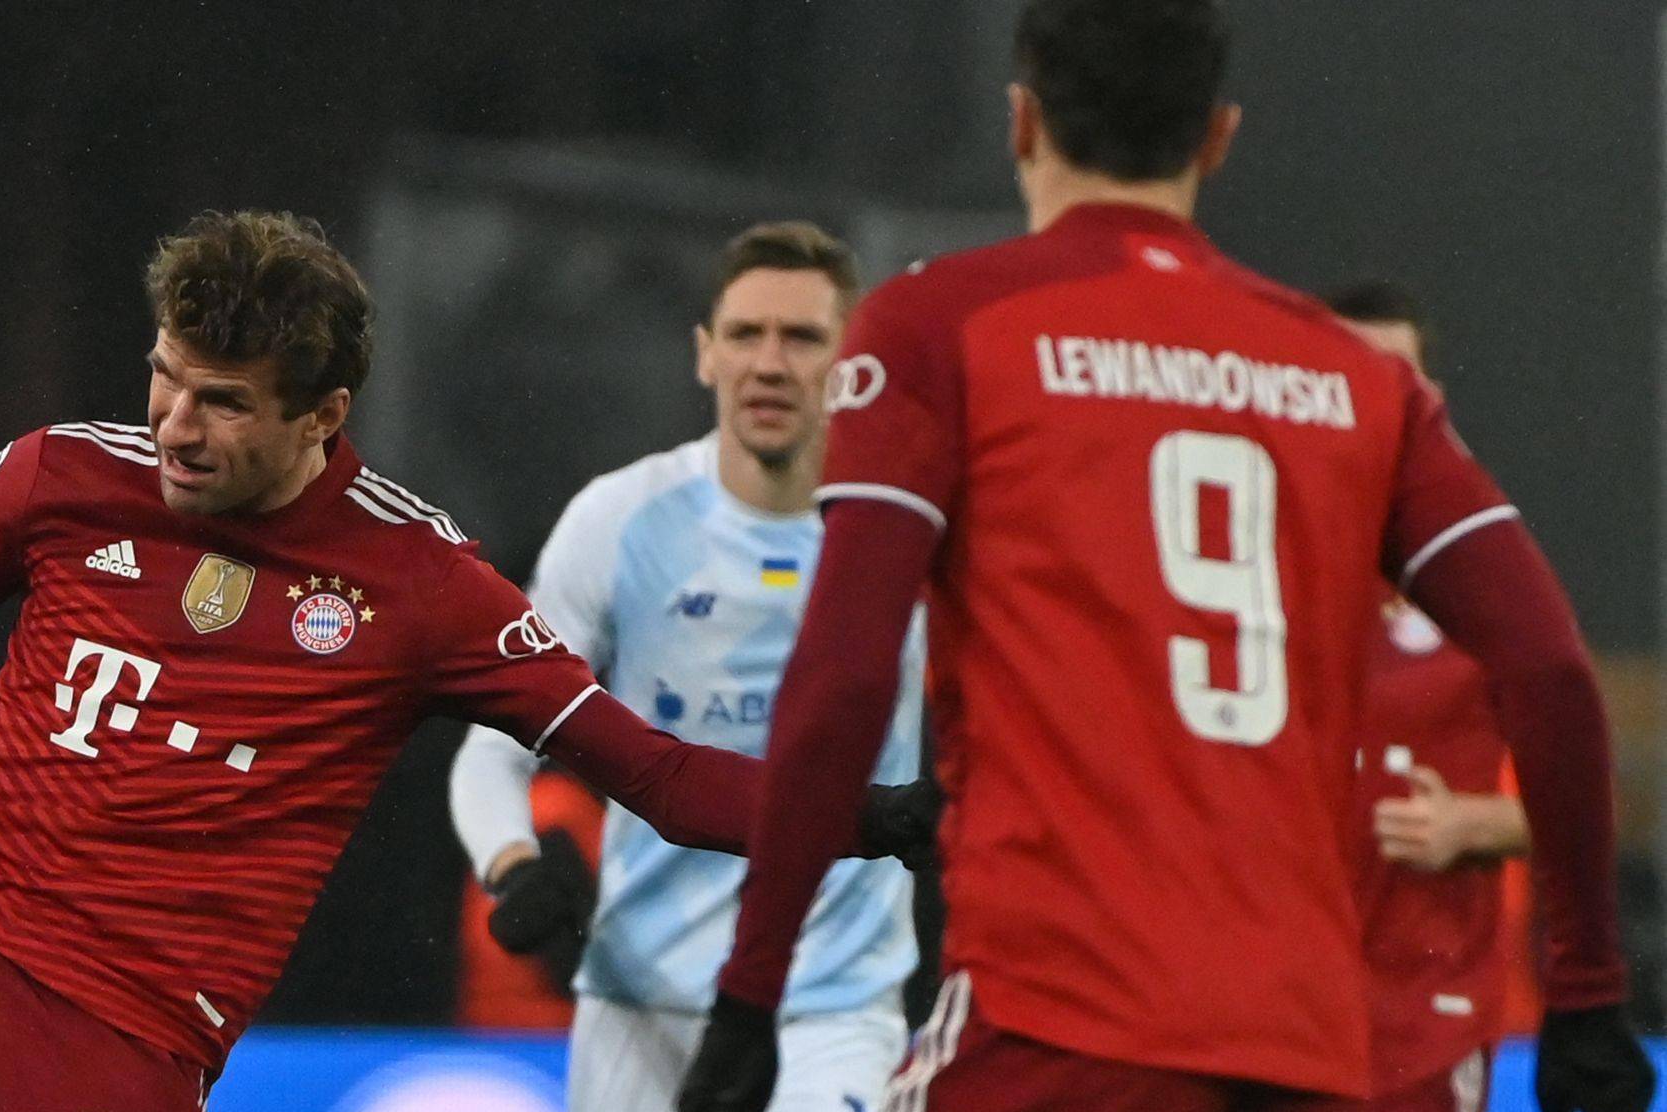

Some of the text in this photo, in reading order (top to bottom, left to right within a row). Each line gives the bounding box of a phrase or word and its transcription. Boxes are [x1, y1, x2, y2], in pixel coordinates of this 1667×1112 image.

[1036, 333, 1356, 430] LEWANDOWSKI
[85, 555, 141, 579] adidas
[1150, 430, 1287, 746] 9
[197, 601, 222, 617] FIFA
[301, 597, 351, 627] FC BAYERN
